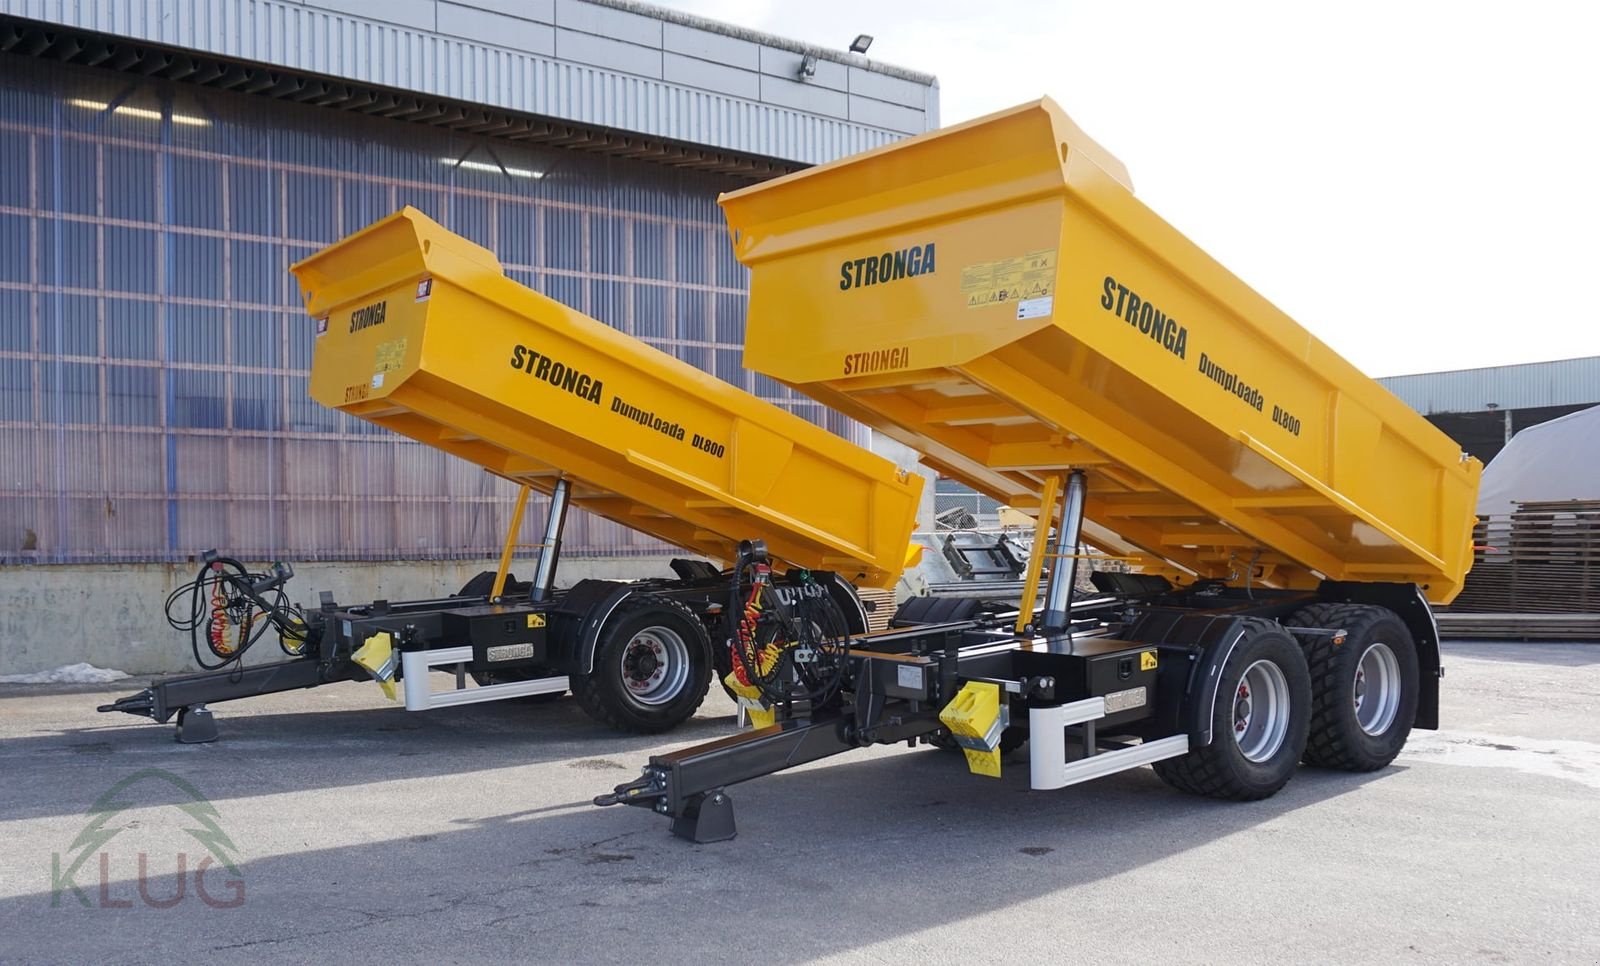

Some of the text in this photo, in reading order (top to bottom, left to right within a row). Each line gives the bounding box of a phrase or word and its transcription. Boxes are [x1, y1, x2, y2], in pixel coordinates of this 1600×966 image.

[840, 242, 936, 291] STRONGA
[350, 300, 387, 333] STRONGA
[844, 347, 909, 375] STRONGA
[1101, 276, 1187, 360] STRONGA
[1198, 352, 1264, 412] DumpLoada
[1272, 405, 1300, 437] DL800
[511, 344, 725, 458] STRONGA DumpLoada DL800
